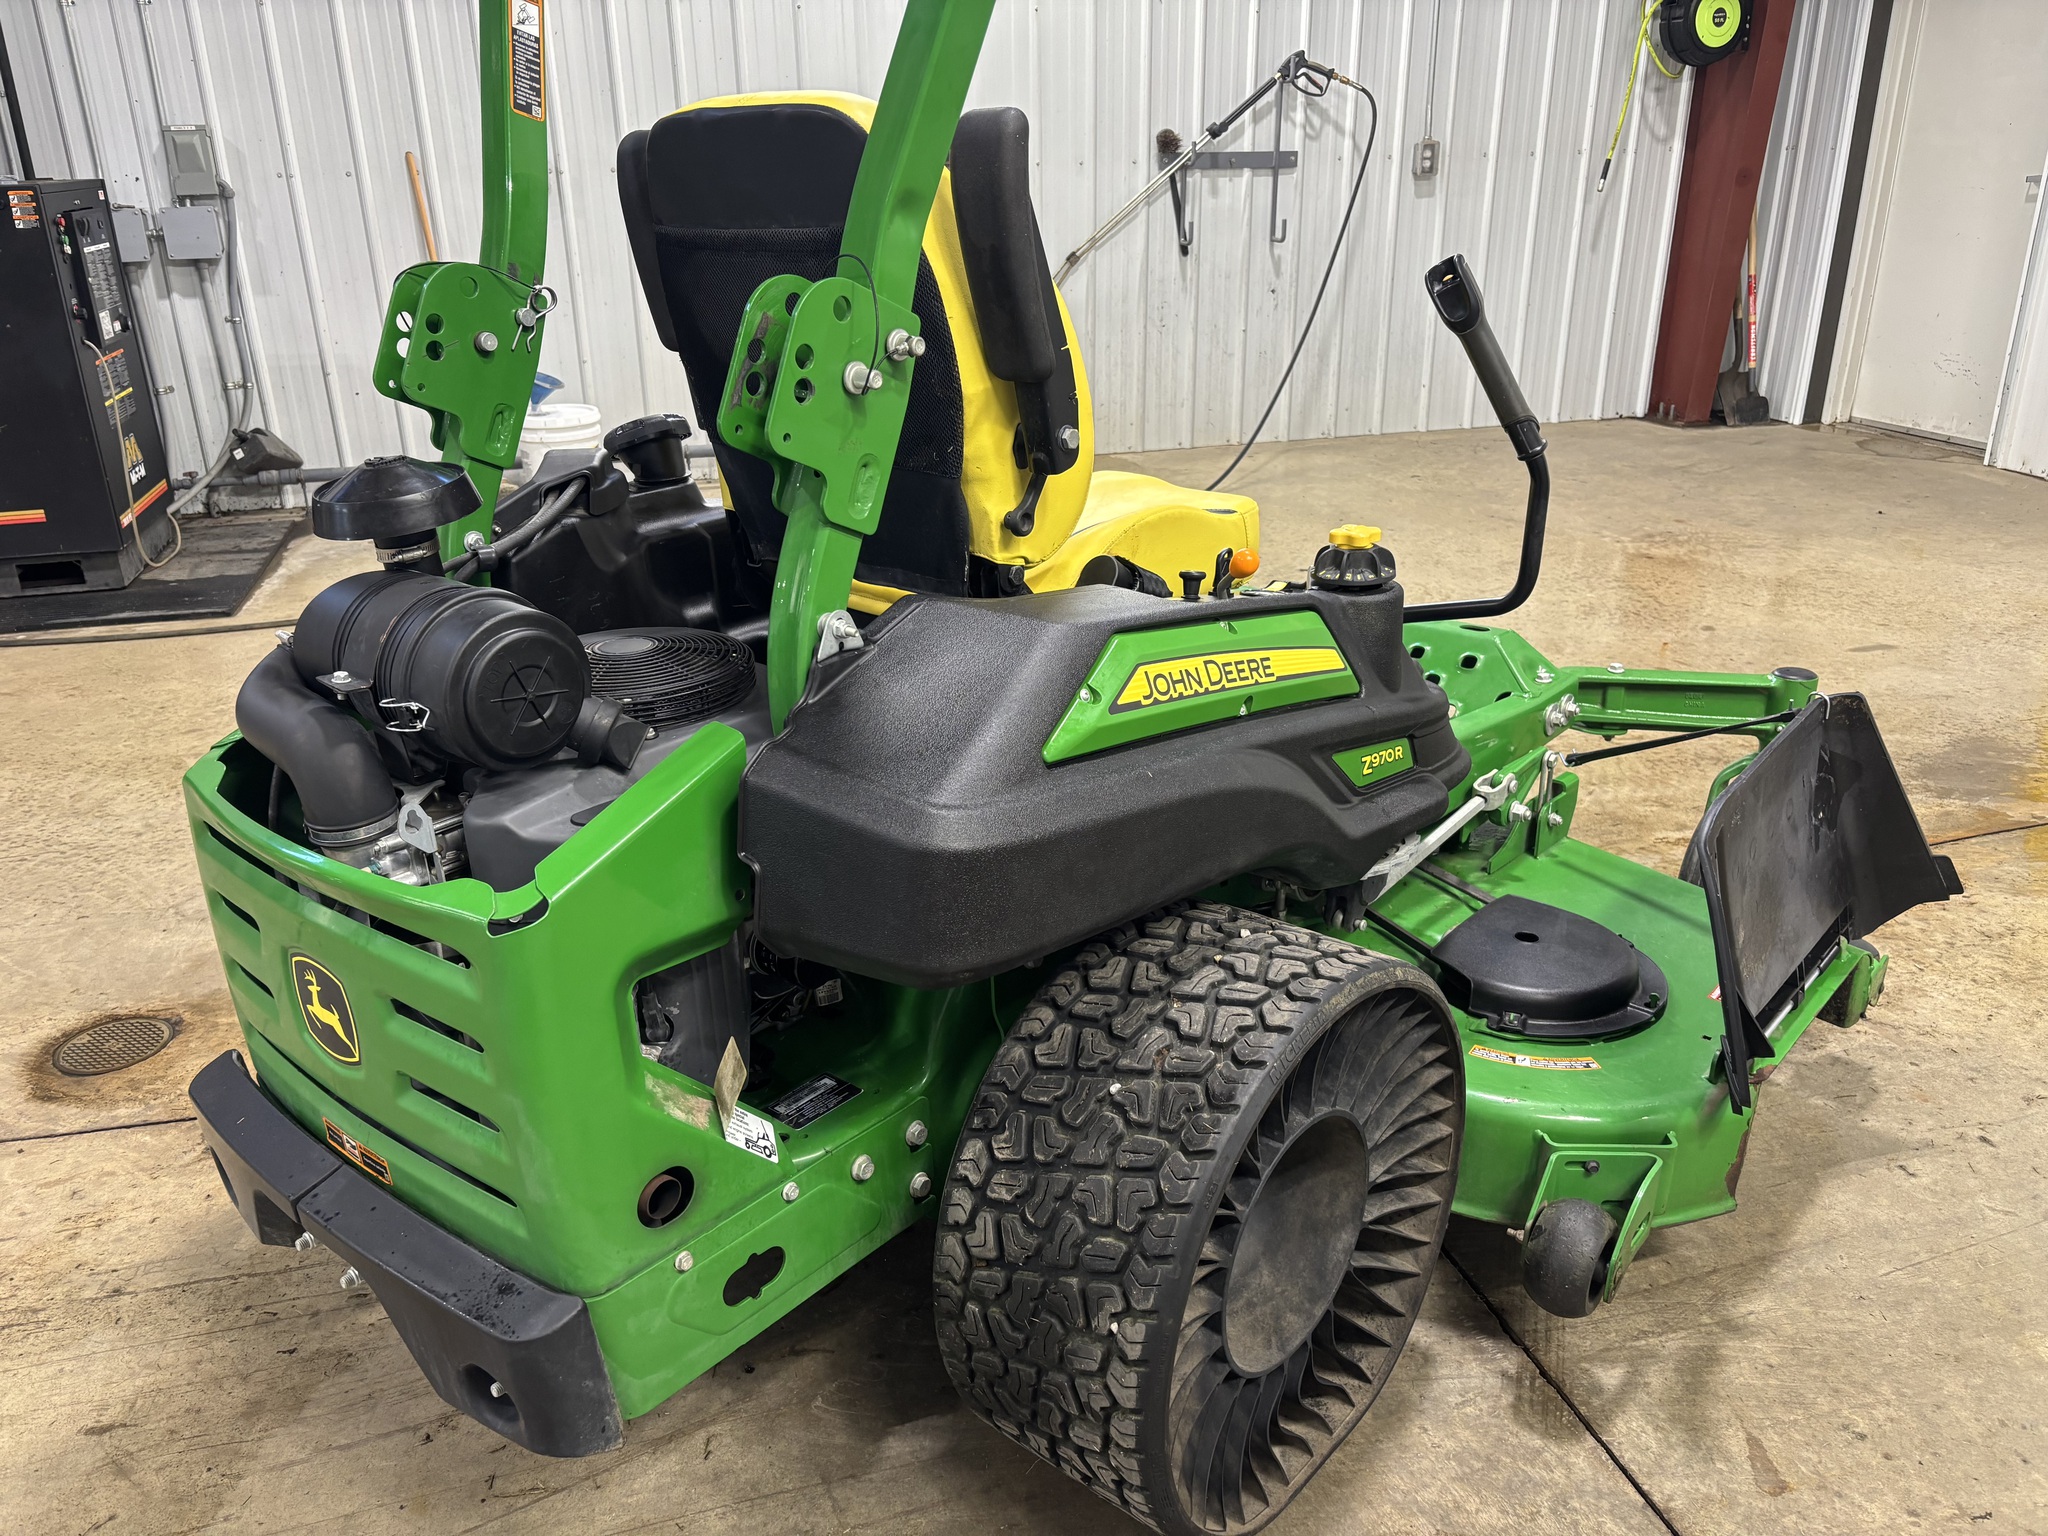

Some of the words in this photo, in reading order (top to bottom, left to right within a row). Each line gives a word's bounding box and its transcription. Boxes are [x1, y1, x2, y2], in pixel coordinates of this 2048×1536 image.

[1142, 667, 1203, 700] JOHN
[1203, 656, 1275, 687] DEERE
[1361, 745, 1404, 776] Z970R
[1269, 1006, 1328, 1086] MICHELIN
